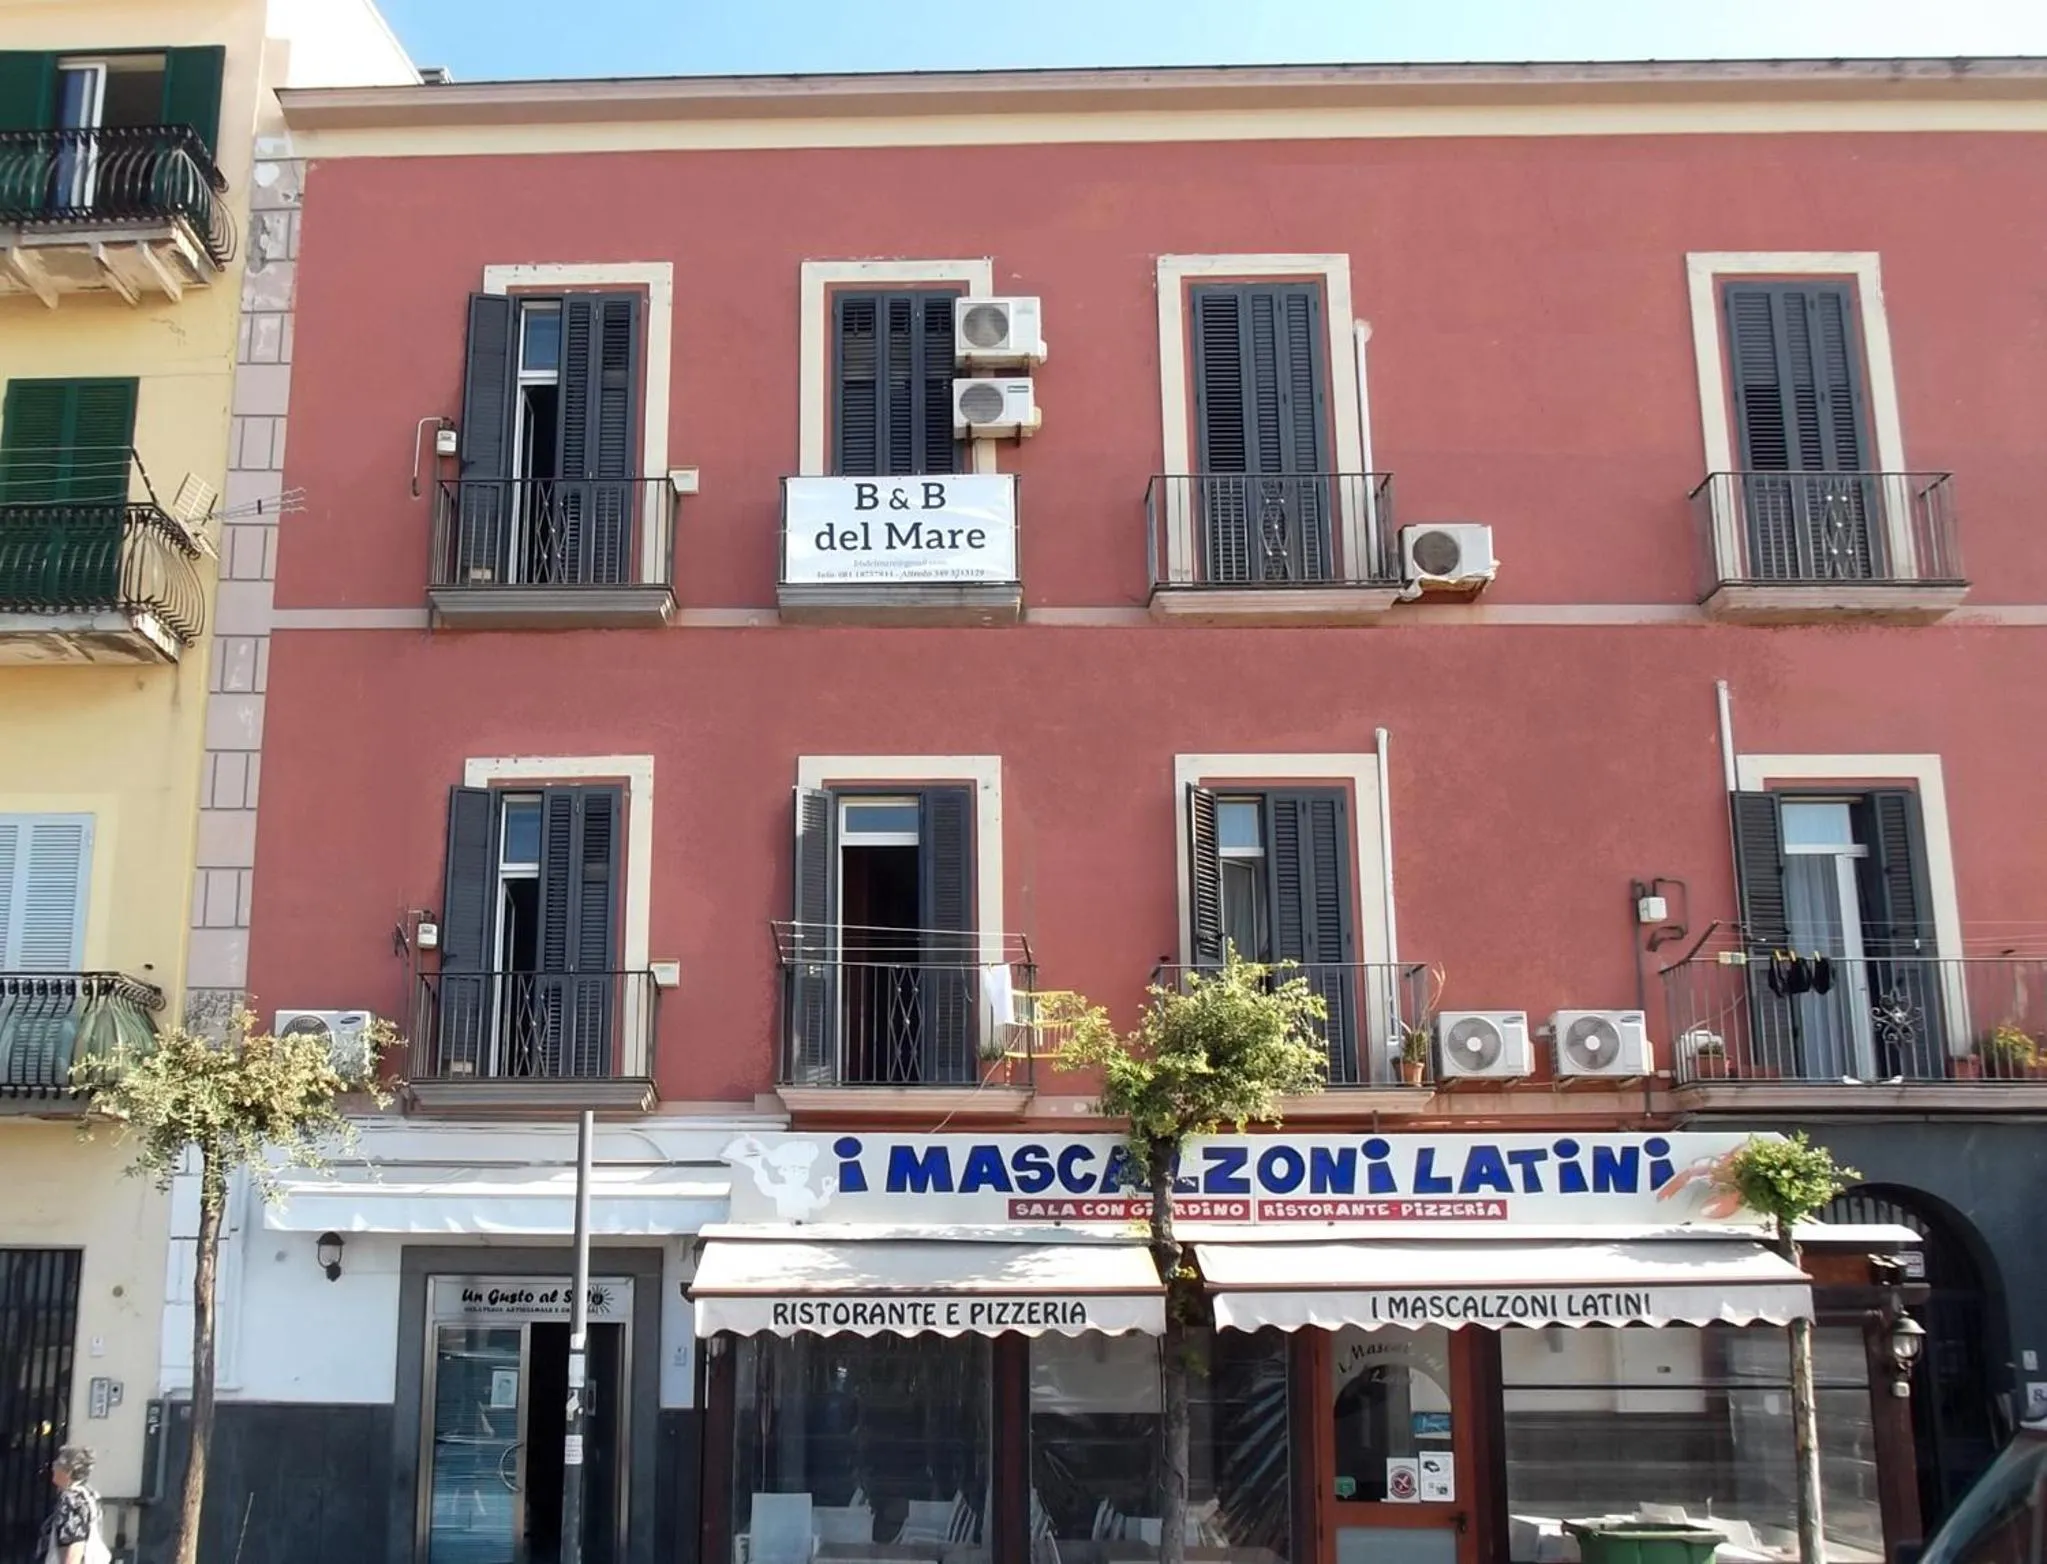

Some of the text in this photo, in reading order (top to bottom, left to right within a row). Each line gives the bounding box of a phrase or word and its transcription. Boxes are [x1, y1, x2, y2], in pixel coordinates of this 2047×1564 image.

[855, 482, 946, 511] B & B
[815, 522, 986, 551] del Mare
[1016, 1203, 1077, 1217] SALA
[1082, 1203, 1125, 1217] CON
[461, 1288, 483, 1303] Un
[487, 1288, 534, 1306] Gusto
[538, 1288, 558, 1304] al
[1371, 1293, 1651, 1319] I MASCALZONI LATINI
[773, 1301, 1088, 1327] RISTORANTE E PIZZERIA
